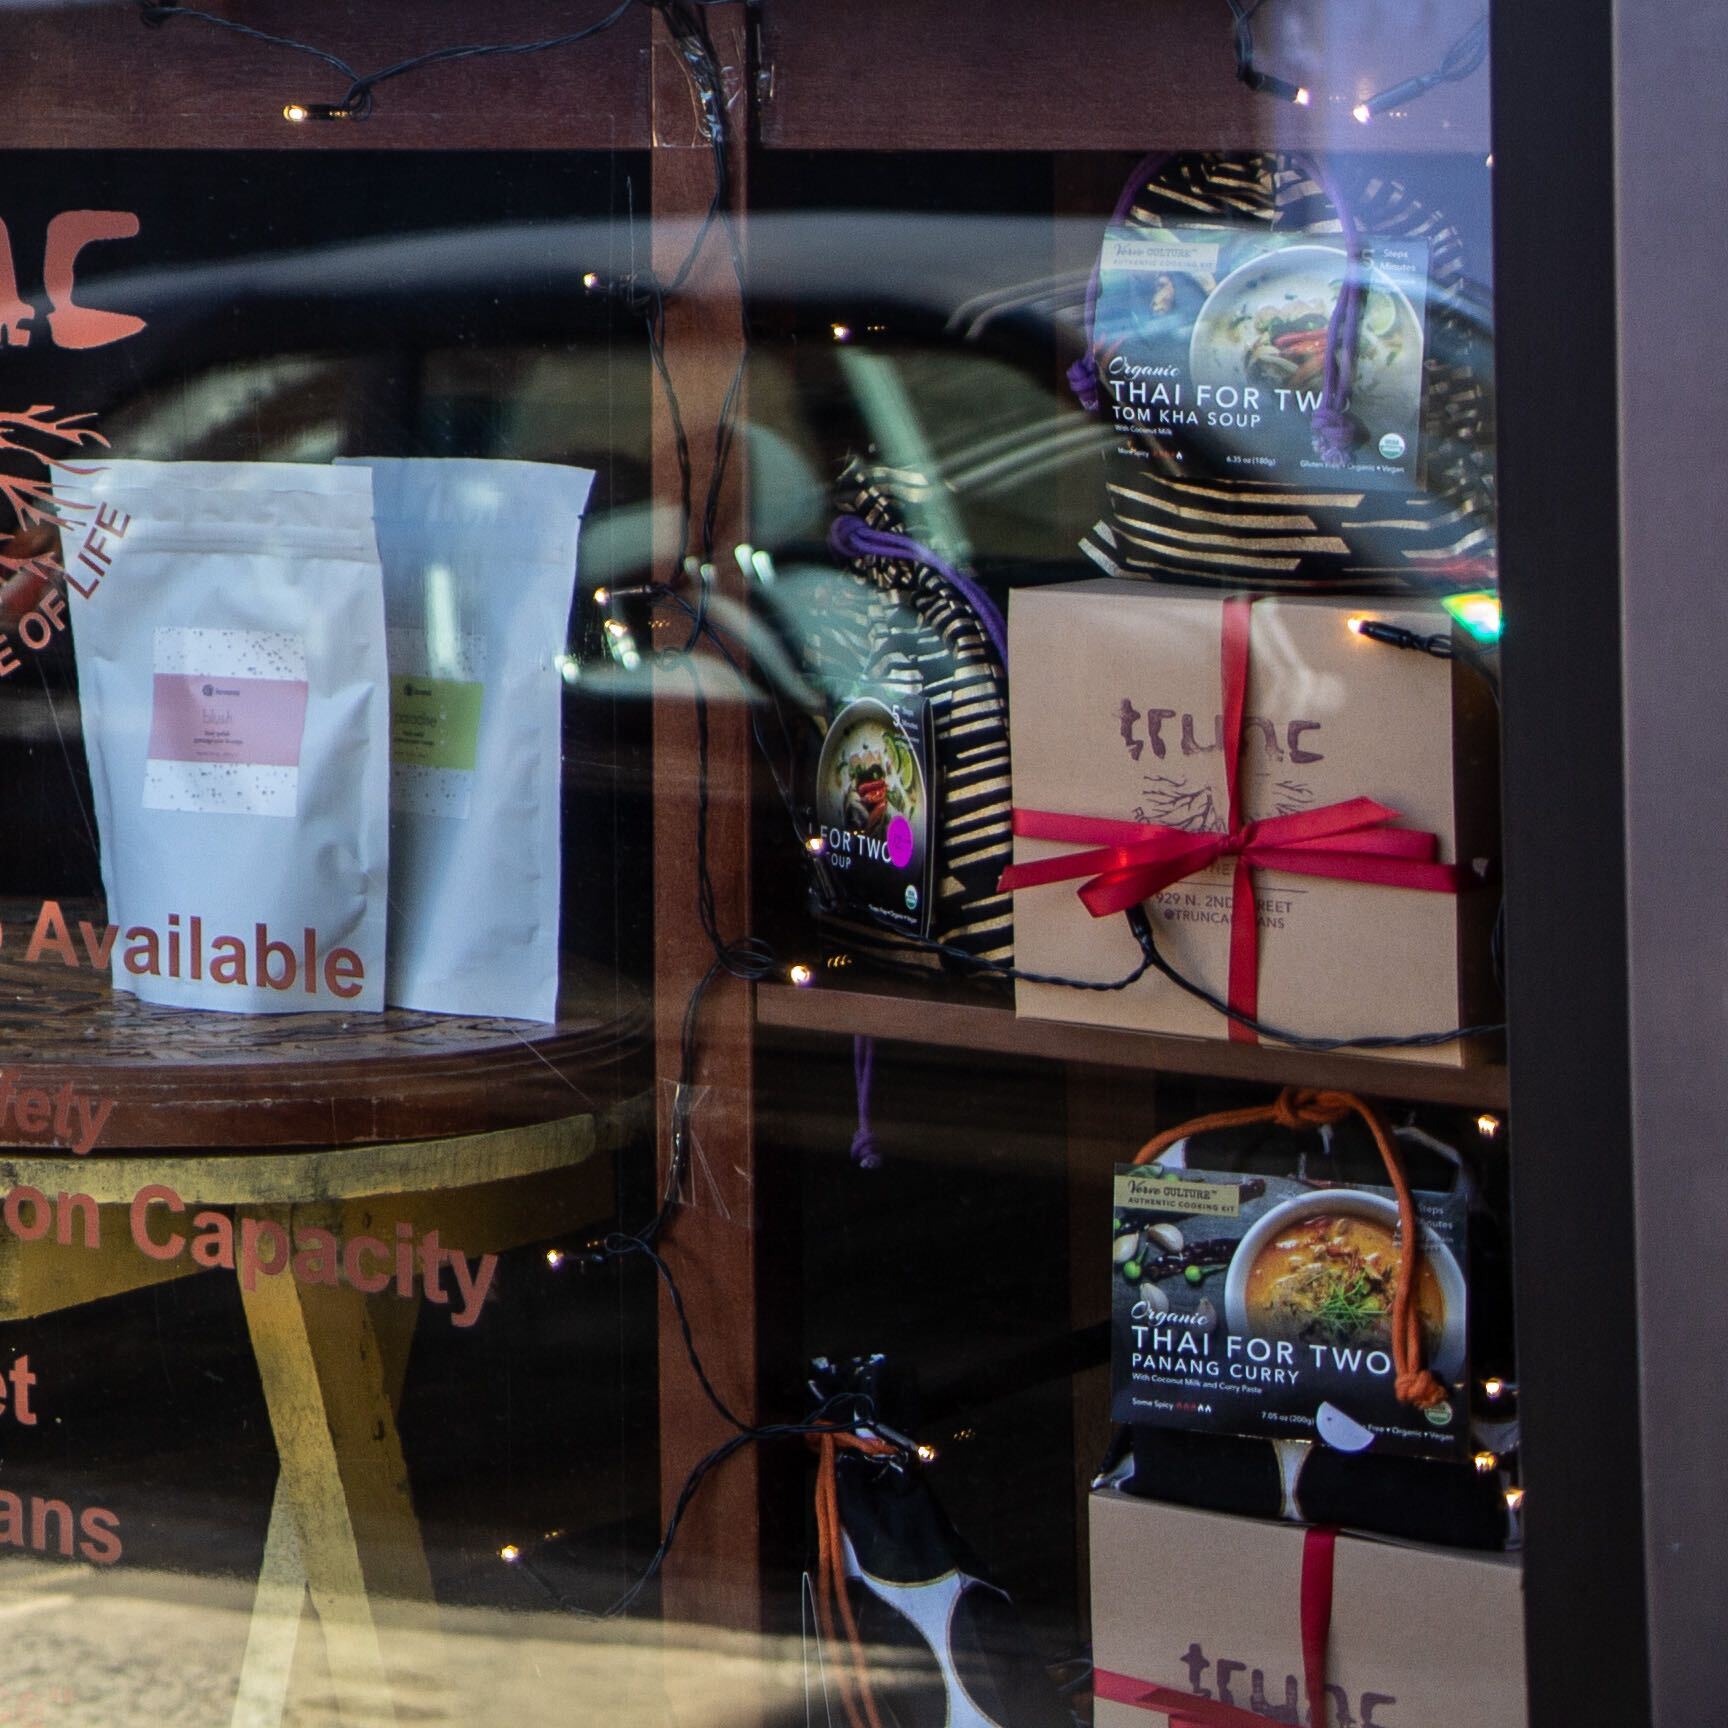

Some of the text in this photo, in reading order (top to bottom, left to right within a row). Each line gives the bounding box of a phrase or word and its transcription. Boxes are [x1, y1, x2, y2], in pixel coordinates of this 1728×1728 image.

[1108, 355, 1181, 379] Organic
[1109, 379, 1344, 414] THAI FOR TW
[1112, 405, 1262, 428] TOM KHA SOUP
[18, 589, 71, 650] OF
[67, 501, 132, 600] LIFE
[1119, 697, 1325, 764] trunc
[819, 824, 851, 852] FOR
[826, 850, 852, 870] OUP
[1156, 892, 1181, 905] 929
[1258, 900, 1293, 914] REET
[25, 898, 368, 999] Available
[1127, 1197, 1236, 1213] AUTHENTIC COOKING KIT
[127, 1182, 503, 1330] Capacity
[1130, 1299, 1209, 1327] Organic
[1130, 1325, 1392, 1376] THAI FOR TWO
[1130, 1353, 1300, 1385] PANANG CURRY
[1132, 1372, 1264, 1395] With Coconut Milk and Curry Paste
[1153, 1399, 1174, 1411] Spicy
[1261, 1410, 1278, 1421] 7.05
[1392, 1426, 1423, 1439] Organic
[1430, 1430, 1455, 1442] Vegan
